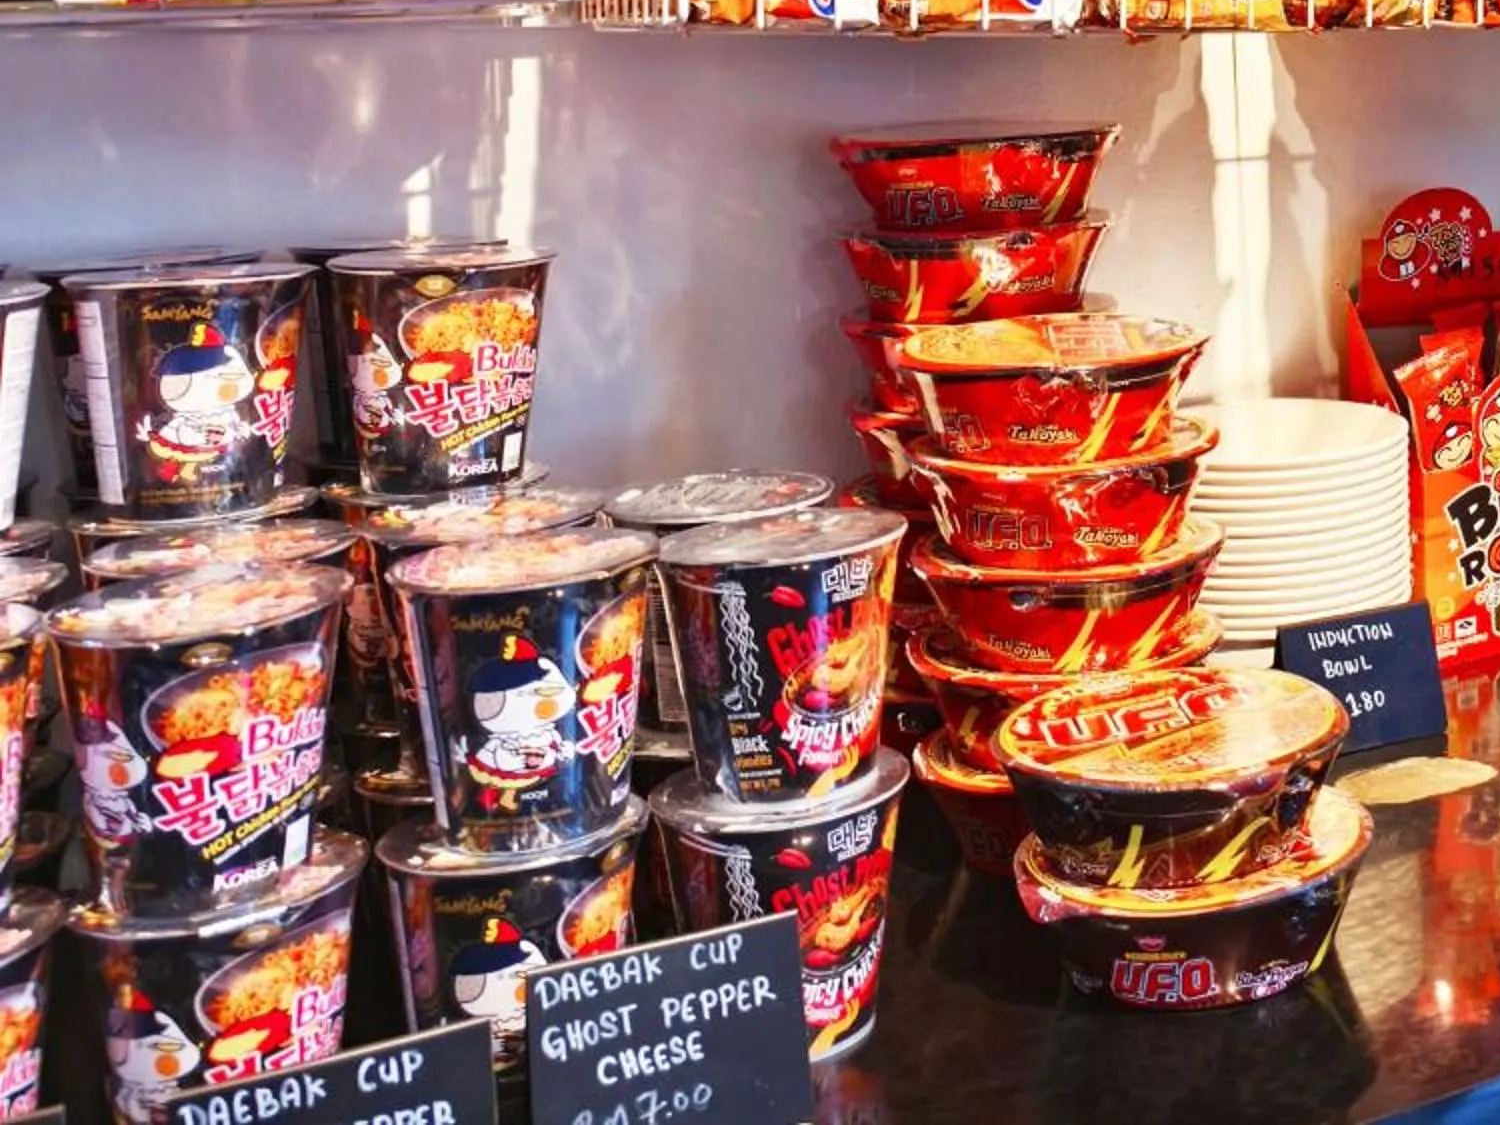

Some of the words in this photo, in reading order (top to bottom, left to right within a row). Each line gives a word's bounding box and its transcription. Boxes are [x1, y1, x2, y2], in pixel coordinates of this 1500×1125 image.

[449, 458, 498, 477] KOREA
[1307, 621, 1394, 652] INDUCTION
[1322, 655, 1373, 679] BOWL
[732, 734, 769, 754] Black
[782, 713, 839, 750] Spicy
[203, 831, 235, 859] HOT
[533, 954, 664, 1011] DAEBAK
[690, 933, 744, 970] CUP
[541, 1003, 638, 1064] GHOST
[661, 976, 778, 1027] PEPPER
[596, 1031, 705, 1086] CHEESE
[178, 1079, 328, 1125] DAEBAK
[356, 1049, 425, 1093] CUP
